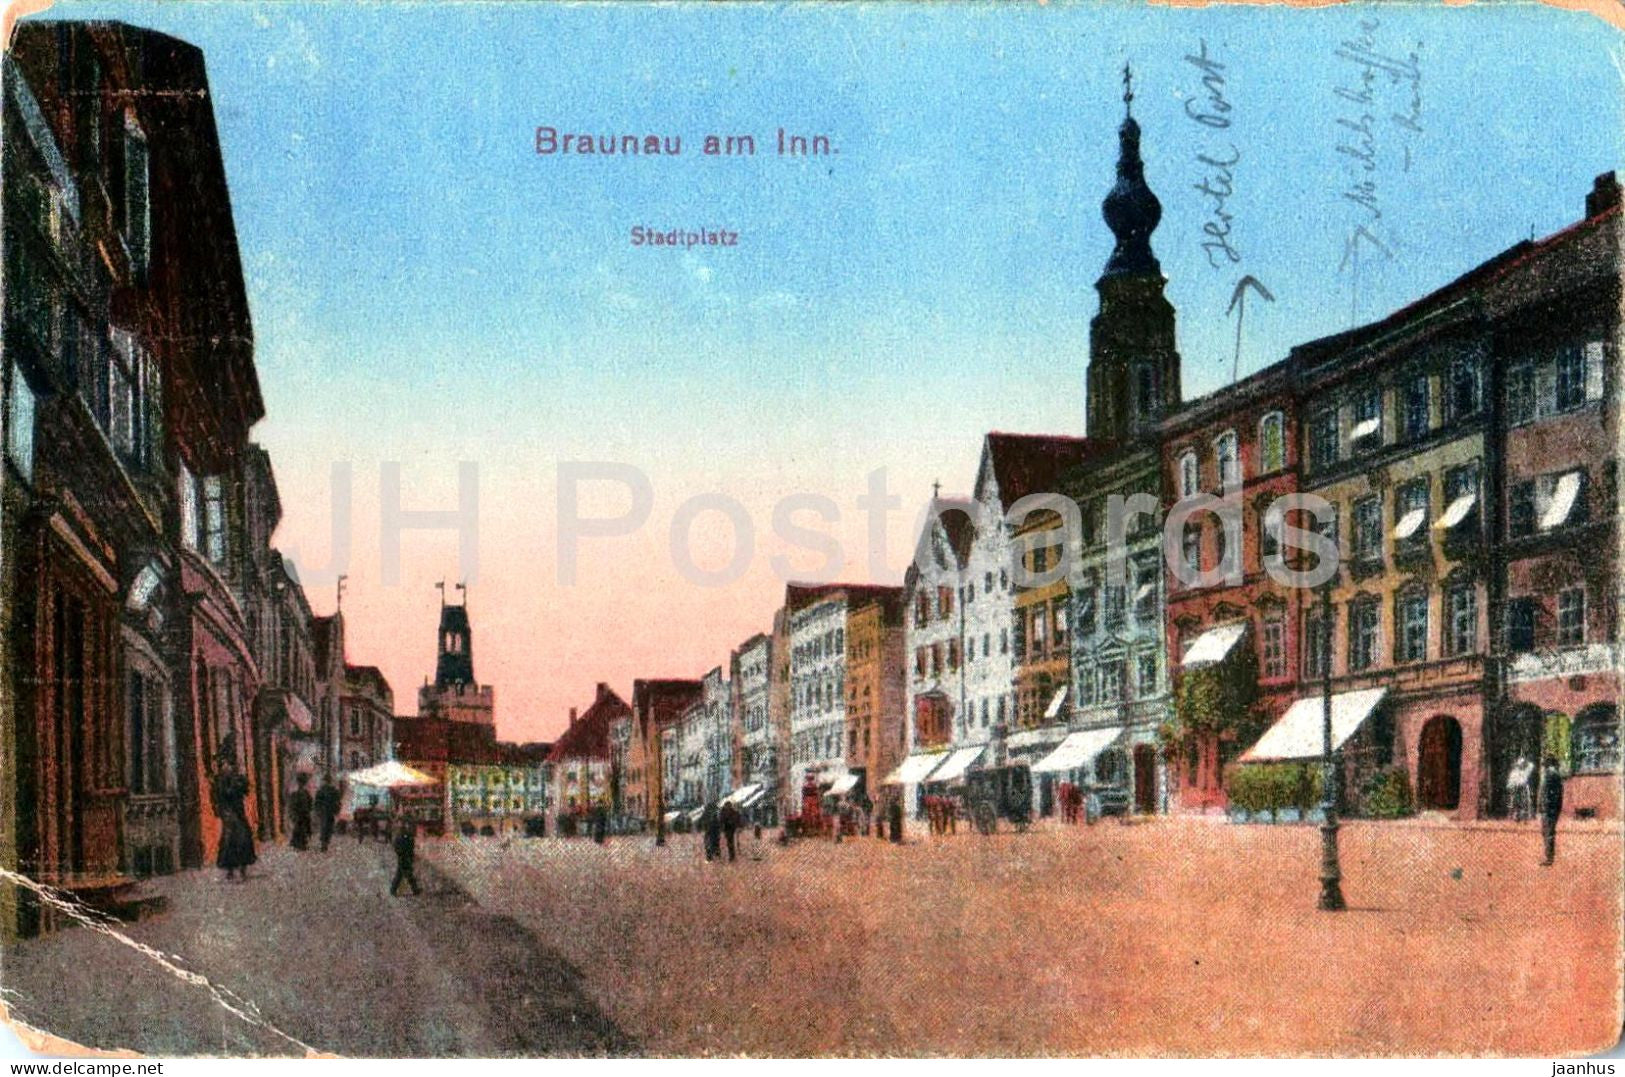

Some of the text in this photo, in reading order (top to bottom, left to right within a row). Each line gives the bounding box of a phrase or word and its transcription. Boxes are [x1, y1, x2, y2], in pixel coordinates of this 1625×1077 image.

[535, 126, 840, 155] Braunau am Inn.
[630, 225, 739, 250] Stadtplatz
